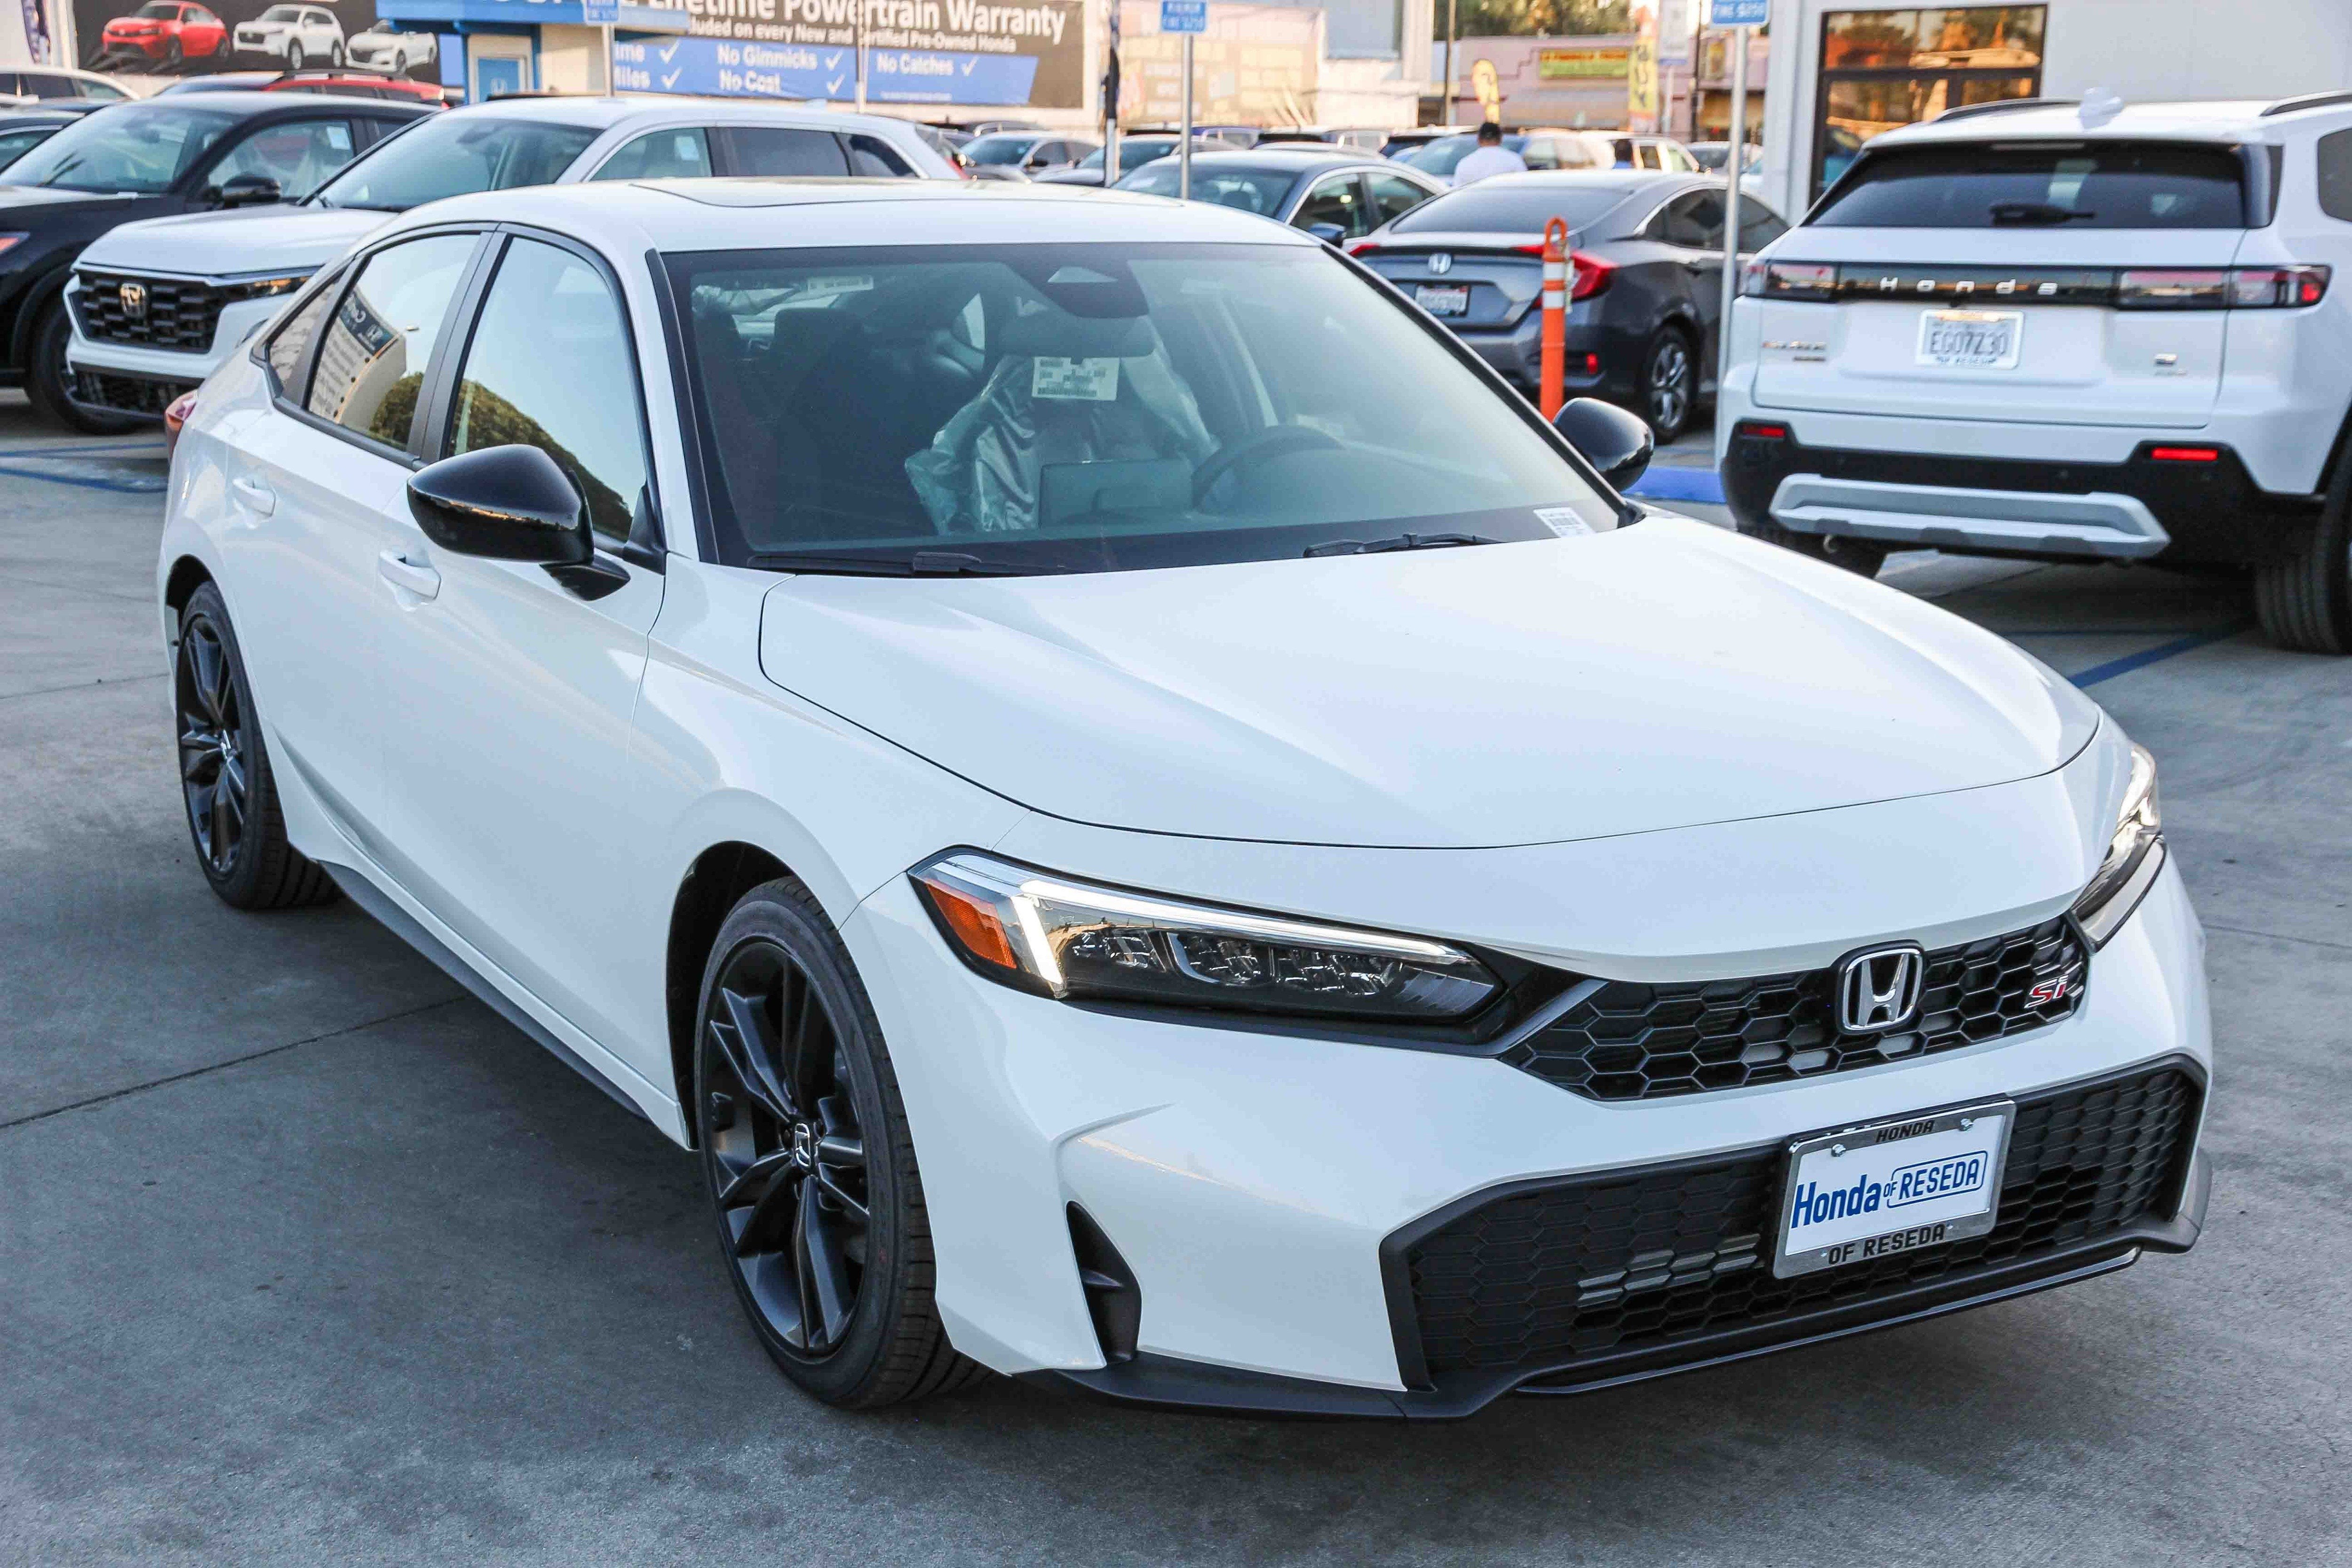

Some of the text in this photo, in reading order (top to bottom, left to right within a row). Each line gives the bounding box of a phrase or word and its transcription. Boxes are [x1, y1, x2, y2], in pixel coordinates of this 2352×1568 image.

[733, 22, 753, 38] on
[754, 23, 794, 43] every
[795, 23, 826, 43] New
[827, 26, 854, 44] and
[978, 35, 1017, 52] Honda
[946, 0, 1066, 46] Warranty
[716, 43, 818, 70] No Gimmicks
[876, 52, 954, 76] No Catches
[719, 68, 742, 91] No
[2024, 974, 2069, 1009] Si
[1875, 1119, 1935, 1143] HONDA
[1790, 1158, 1980, 1229] Honda OF RESEDA
[1828, 1223, 1946, 1265] OF RESEDA
